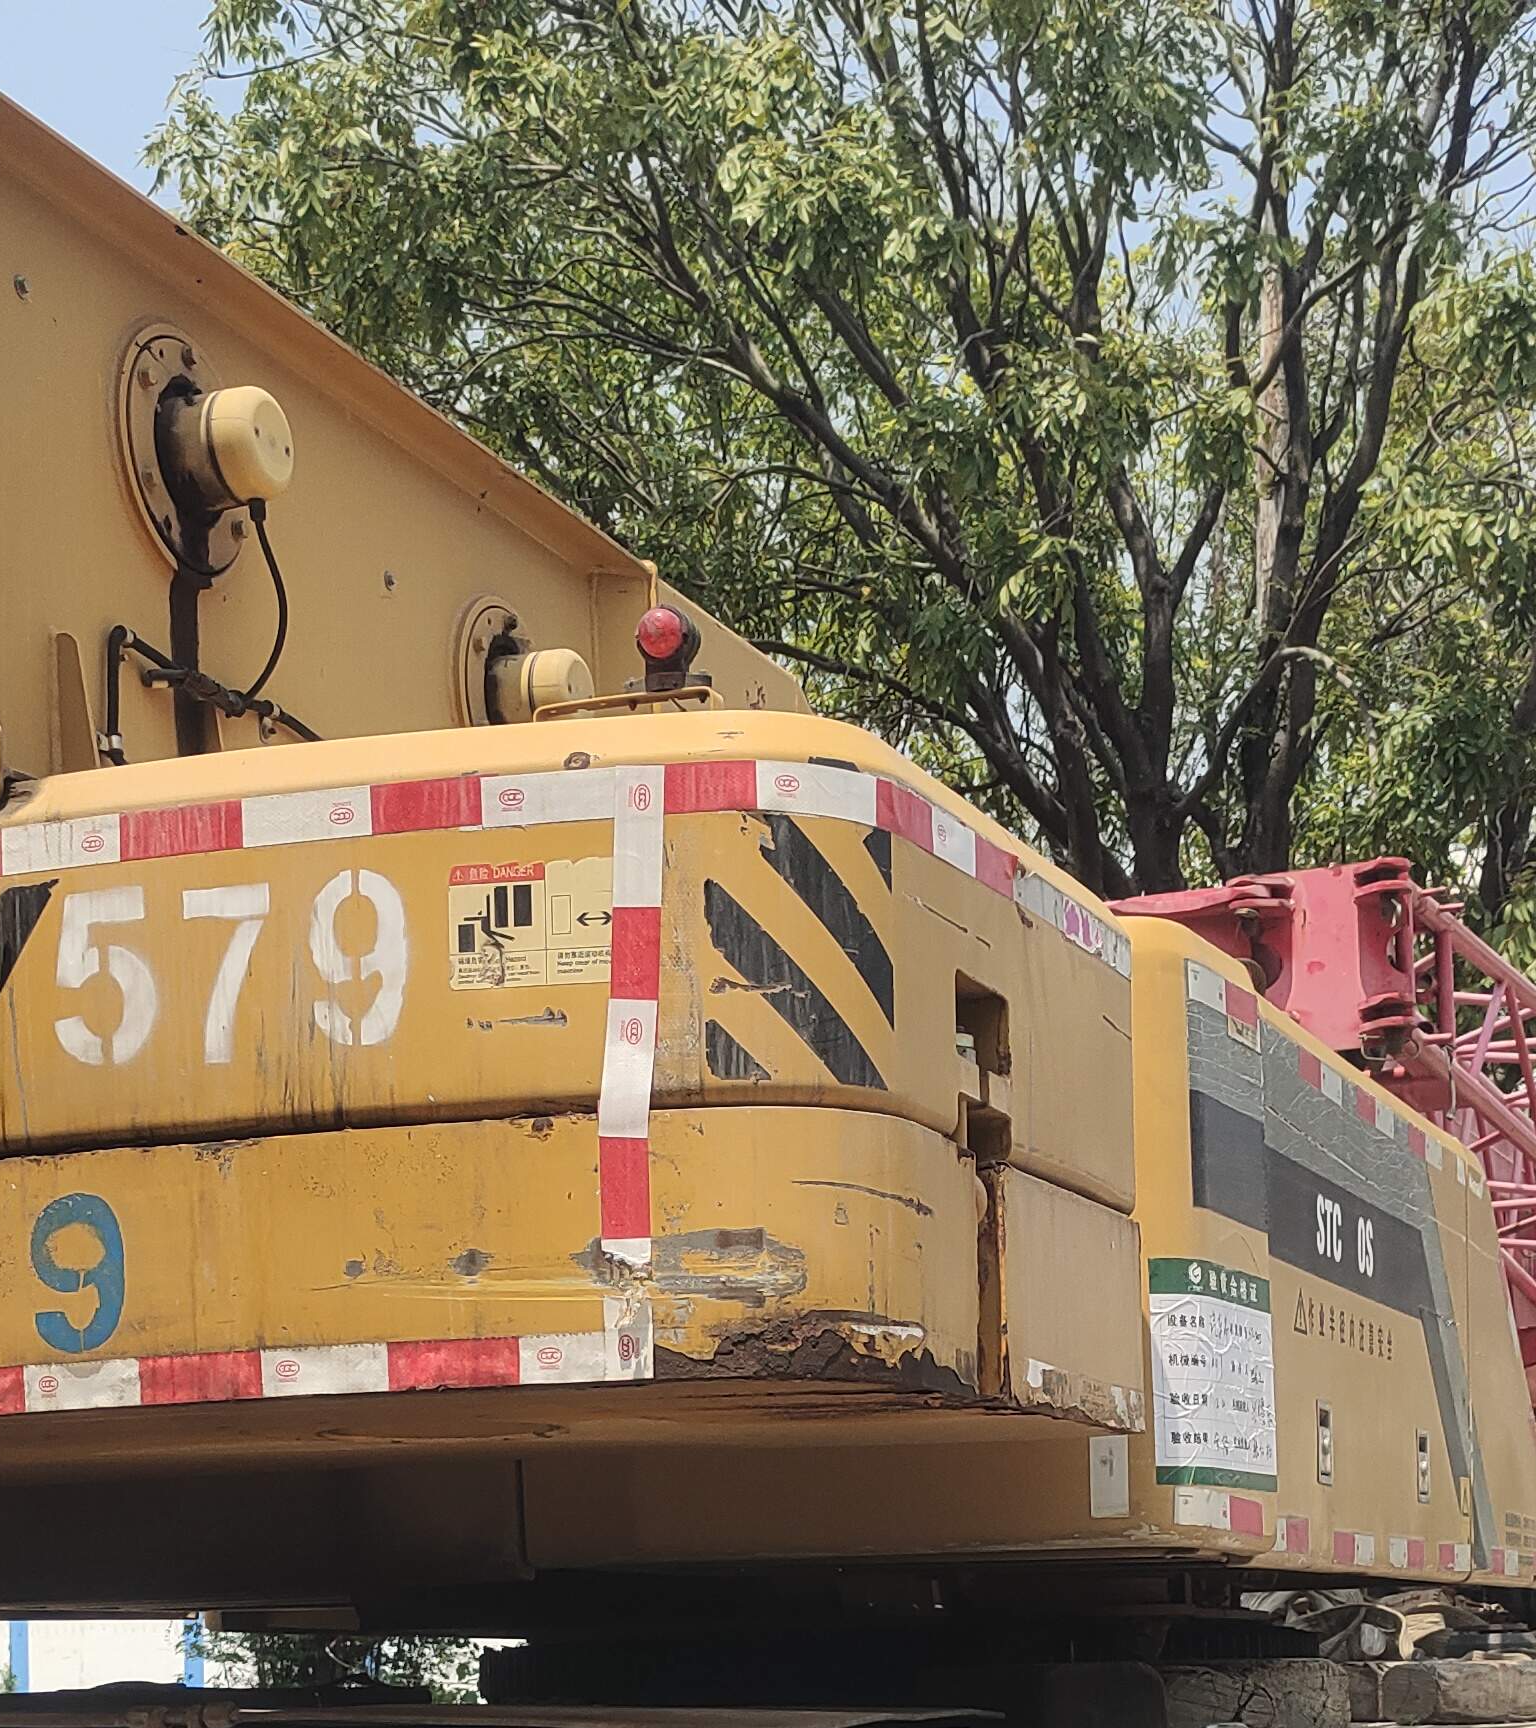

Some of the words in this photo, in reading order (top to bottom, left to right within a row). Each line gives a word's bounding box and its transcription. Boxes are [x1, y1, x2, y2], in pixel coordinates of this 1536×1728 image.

[493, 864, 535, 879] DANGER
[54, 869, 409, 1065] 579
[1316, 1193, 1342, 1263] STC
